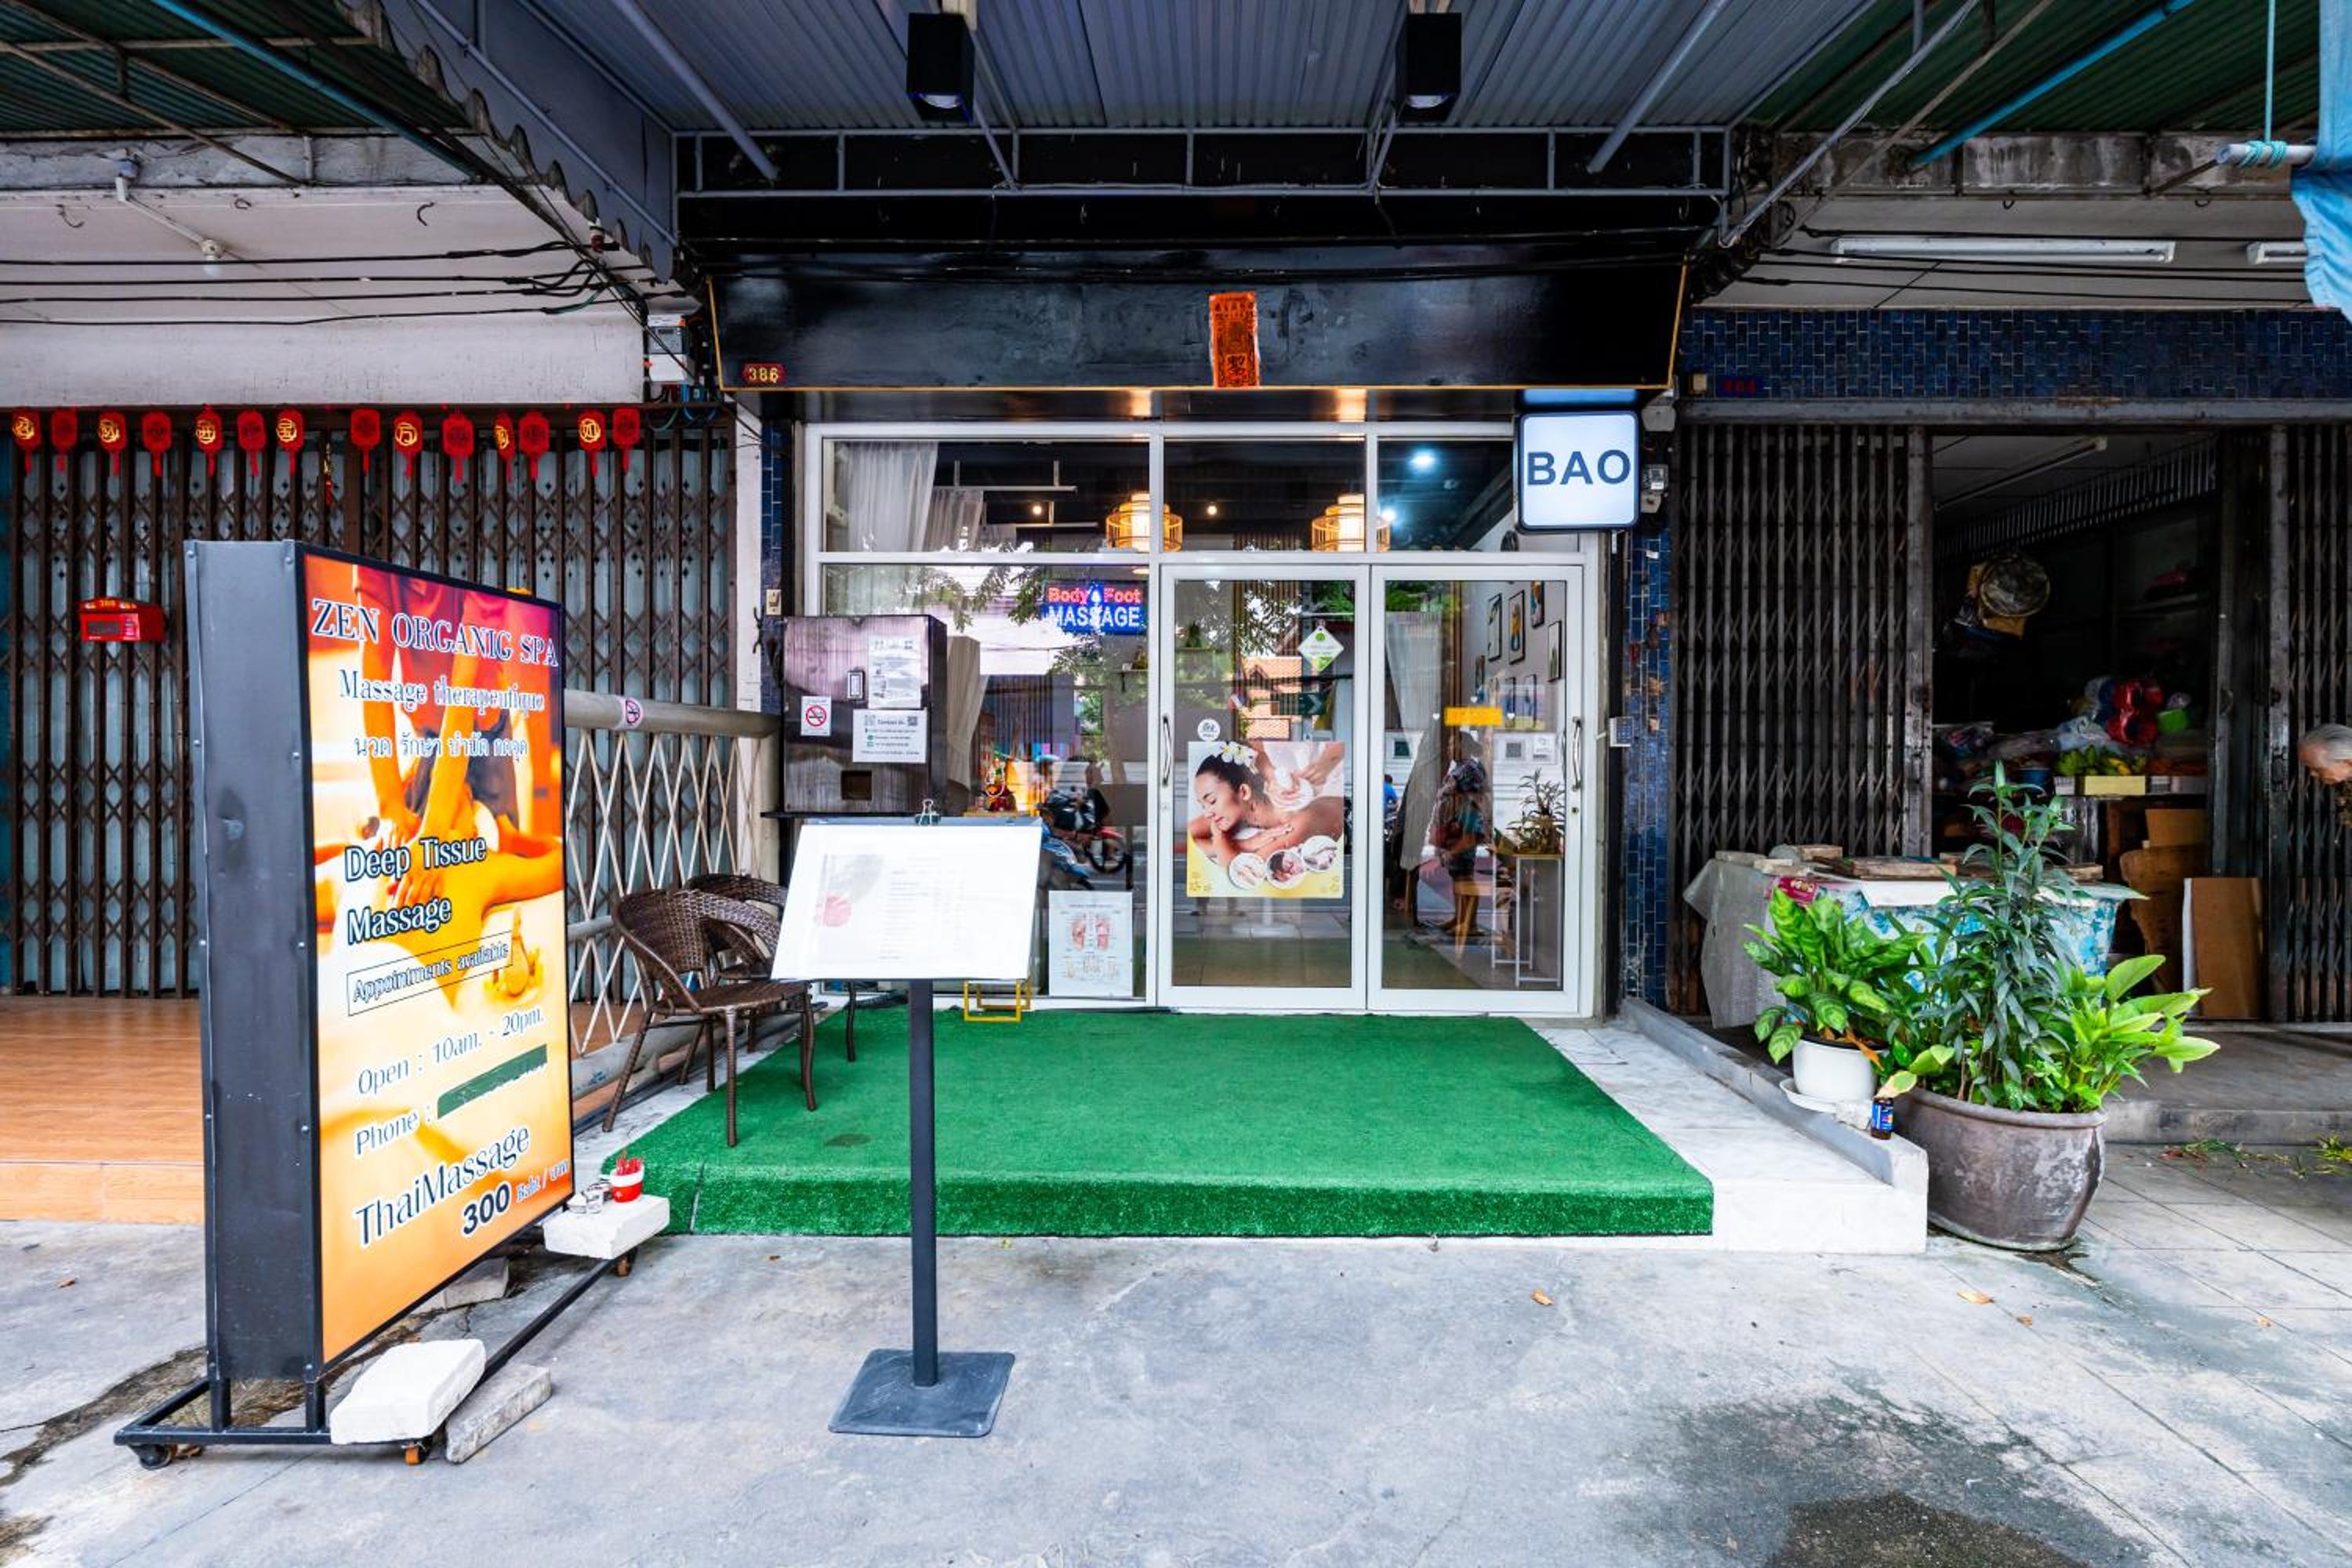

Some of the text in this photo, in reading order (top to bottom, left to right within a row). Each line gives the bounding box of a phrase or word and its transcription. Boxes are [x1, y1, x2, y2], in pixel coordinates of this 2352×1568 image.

[749, 367, 779, 383] 386
[1528, 449, 1632, 485] BAO
[1048, 587, 1142, 604] Body Foot
[312, 597, 380, 644] ZEN
[519, 633, 560, 667] SPA
[339, 668, 545, 717] Massage therapeutique
[354, 737, 391, 757] นวด
[344, 836, 487, 882] Deep Tissue
[347, 898, 452, 946] Massage
[352, 941, 510, 1004] Appointments available
[358, 1058, 409, 1095] Open
[432, 1030, 482, 1064] 10am.
[502, 1007, 544, 1037] 20pm.
[355, 1110, 419, 1156] Phone
[354, 1126, 531, 1247] ThaiMassage
[461, 1182, 512, 1236] 300
